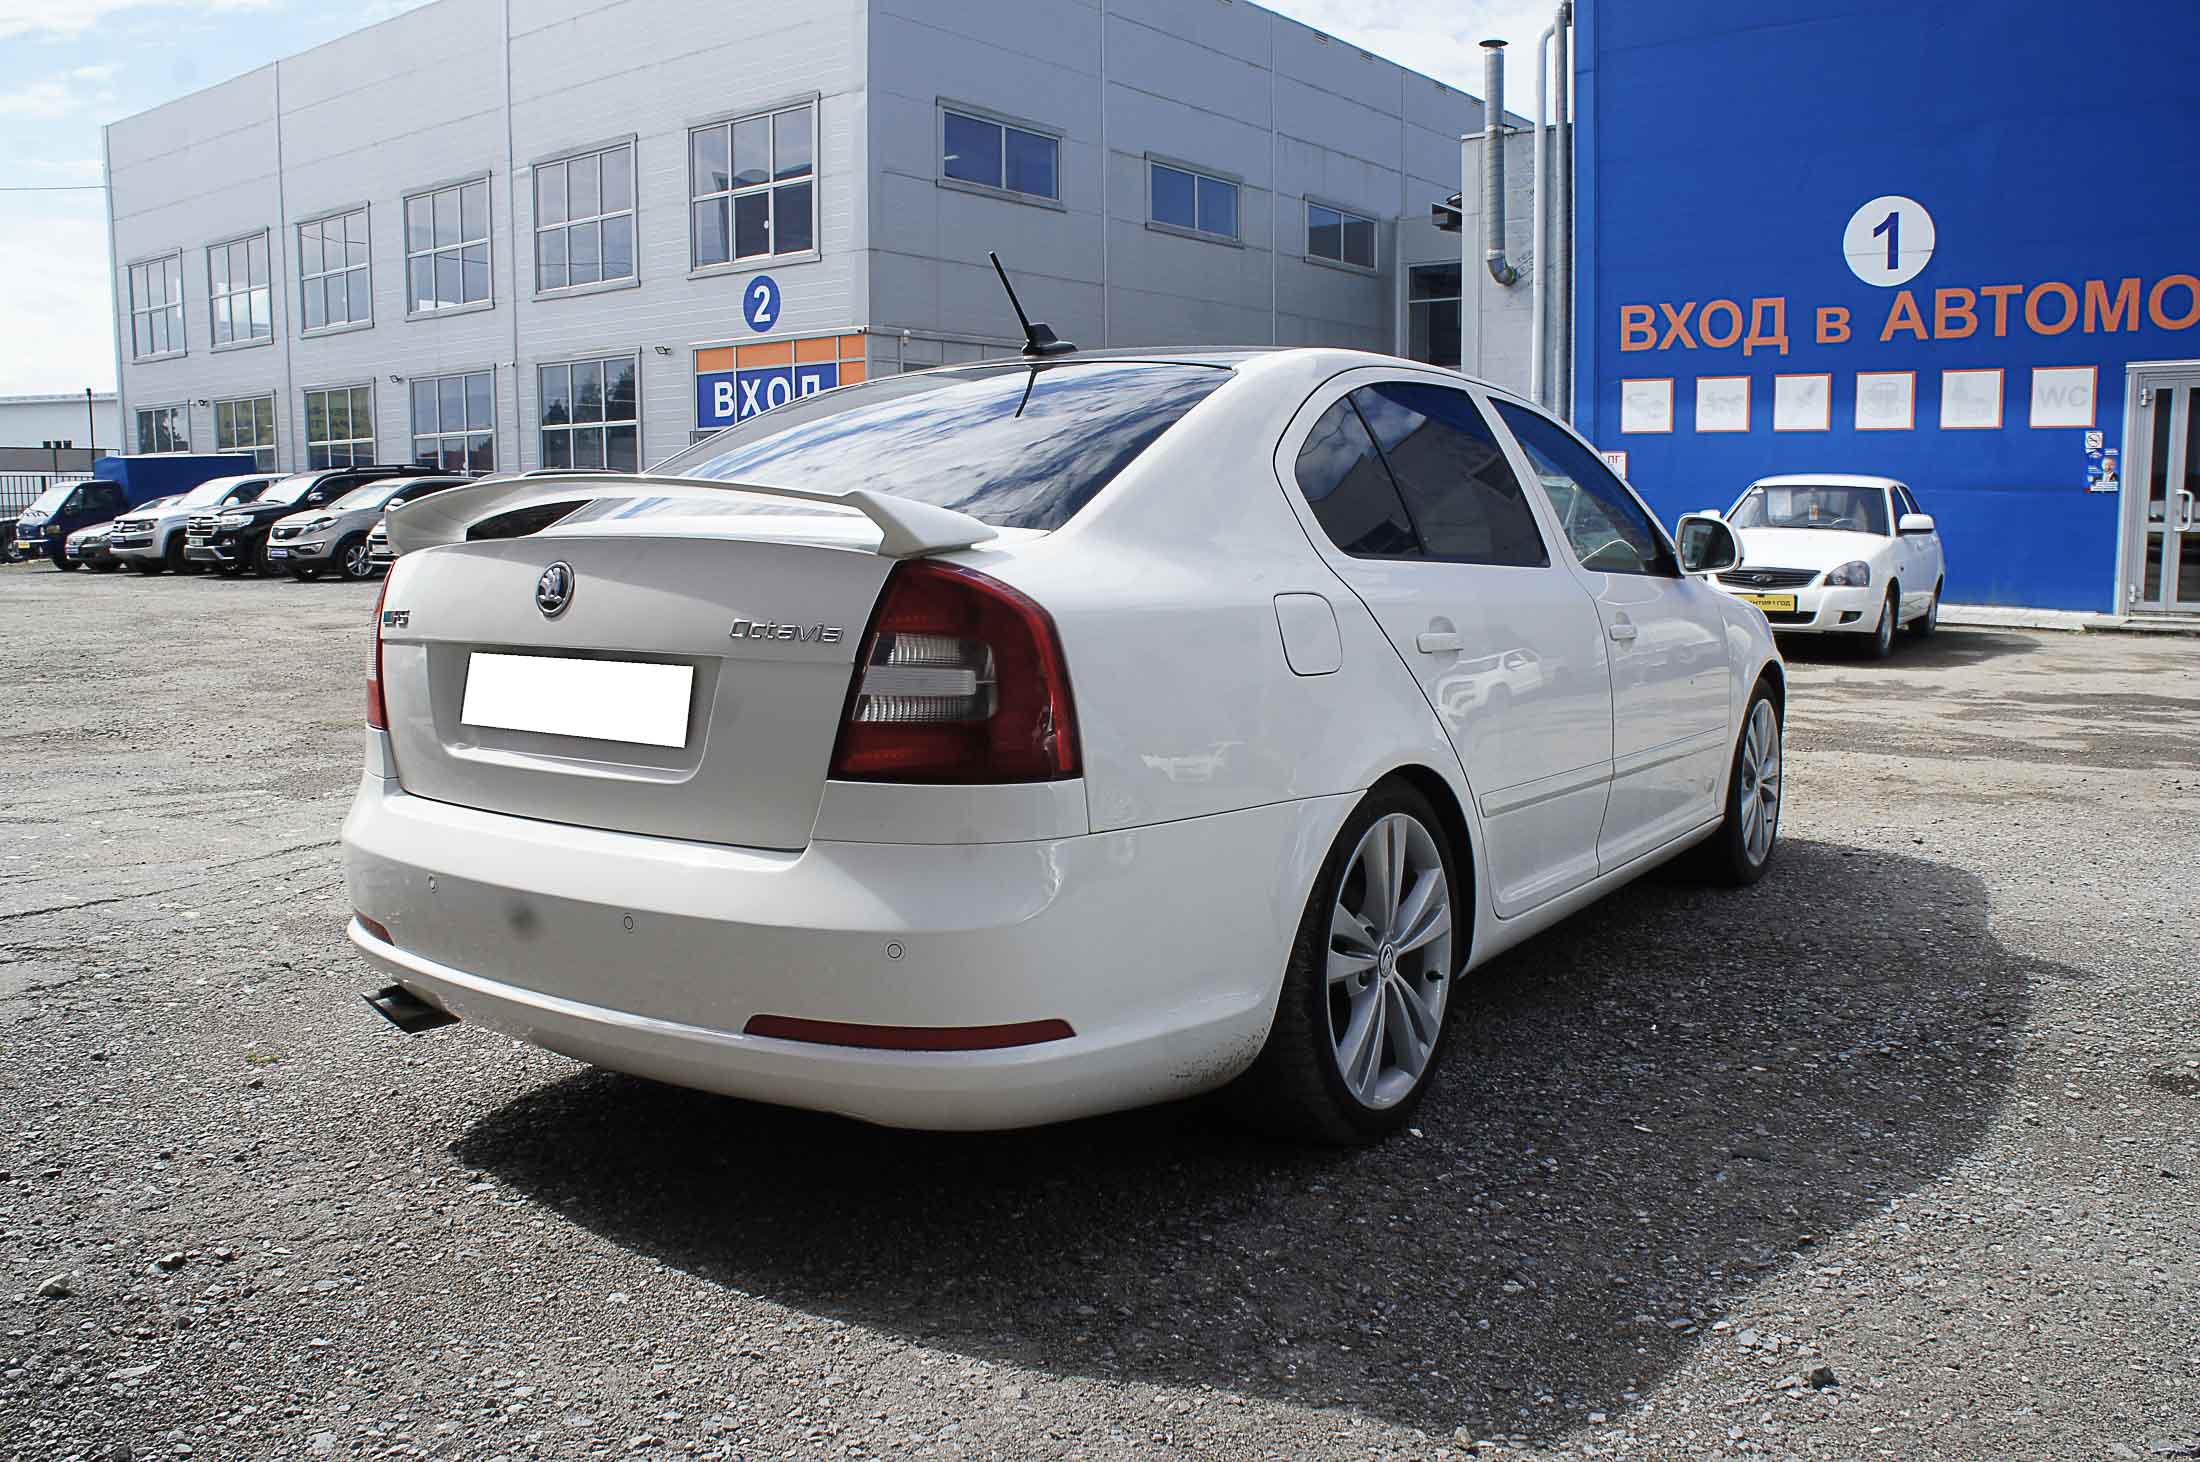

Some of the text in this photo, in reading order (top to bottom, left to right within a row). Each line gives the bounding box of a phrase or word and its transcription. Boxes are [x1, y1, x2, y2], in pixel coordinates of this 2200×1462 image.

[1873, 211, 1899, 270] 1
[753, 284, 771, 323] 2
[1620, 274, 2200, 356] ВХОД в АВТОМО
[2039, 385, 2088, 408] WC
[729, 618, 845, 643] Octavia
